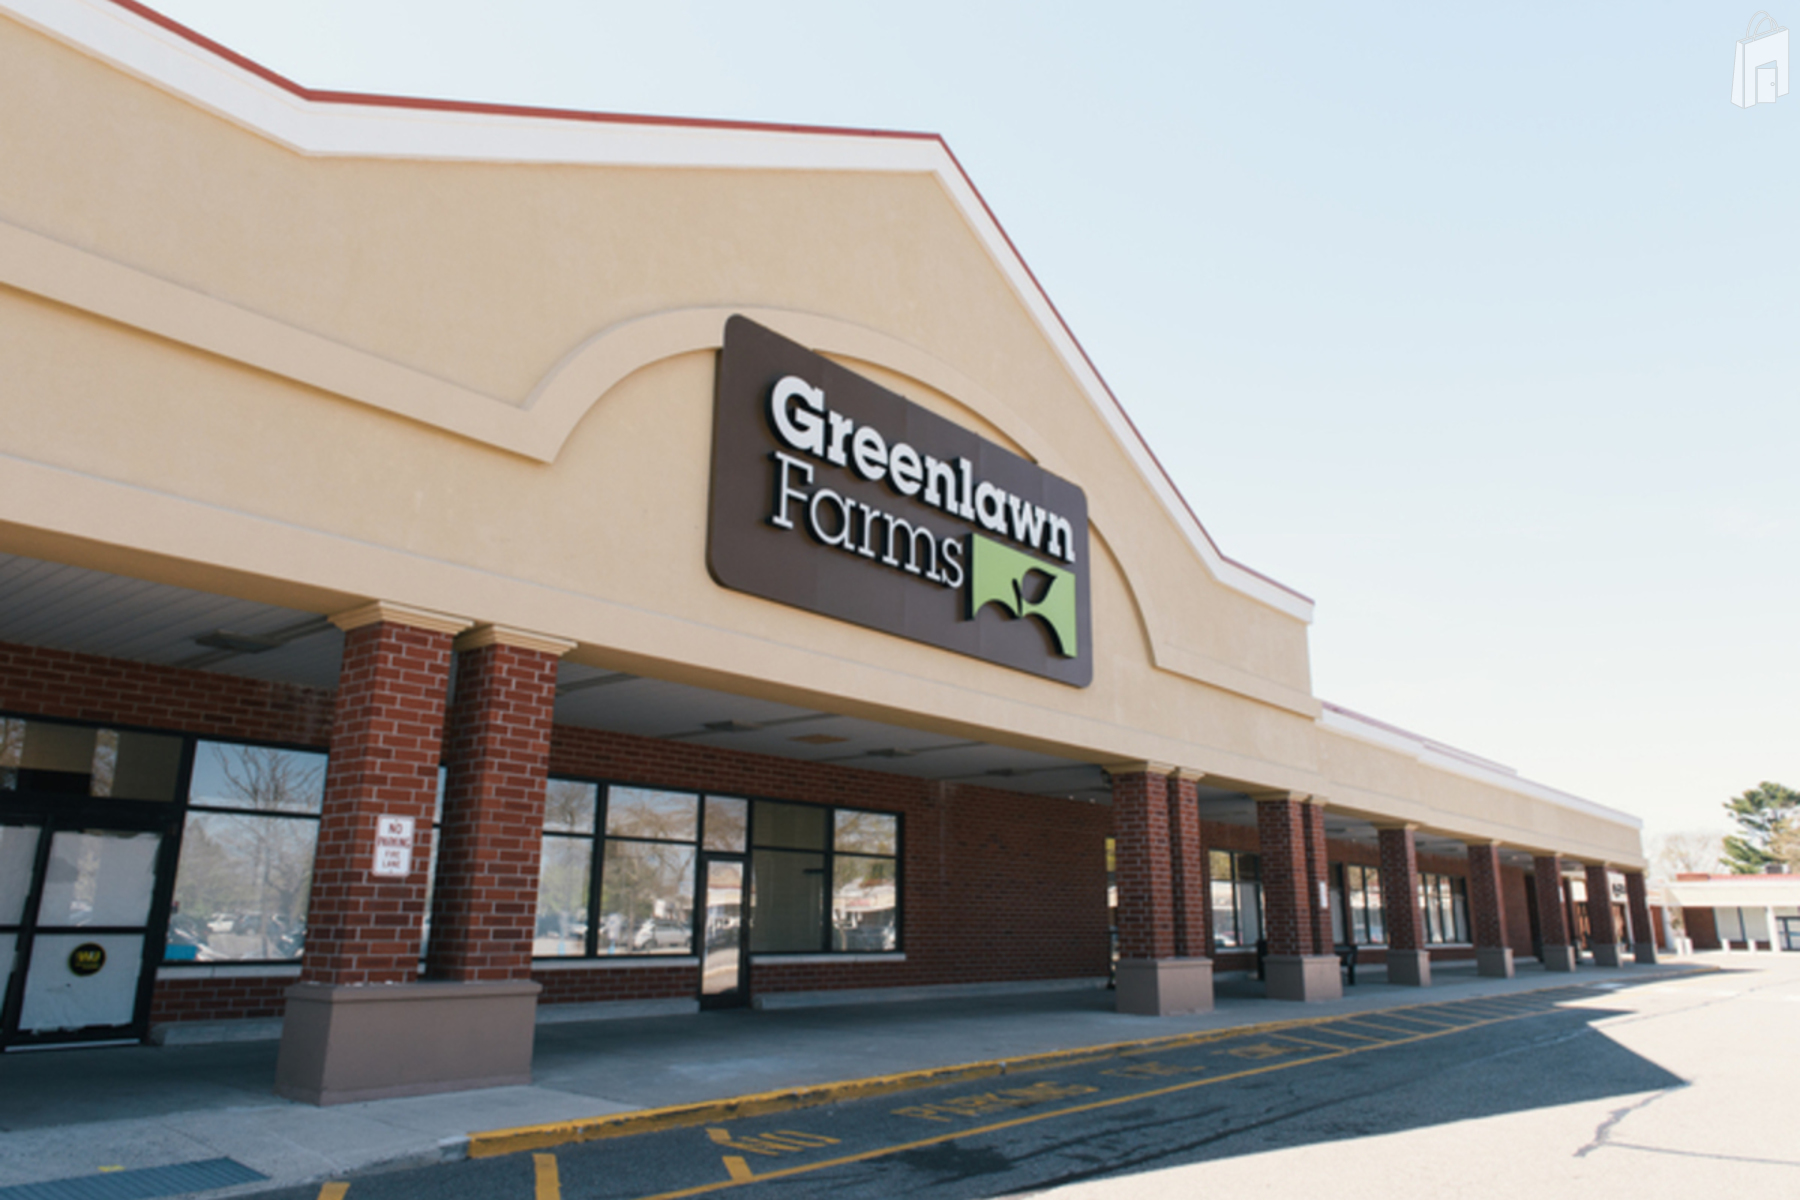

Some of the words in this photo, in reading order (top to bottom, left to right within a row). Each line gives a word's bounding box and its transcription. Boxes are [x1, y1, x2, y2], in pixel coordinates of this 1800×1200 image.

[771, 375, 1076, 563] Greenlawn
[771, 451, 964, 589] Farms
[388, 822, 404, 835] NO
